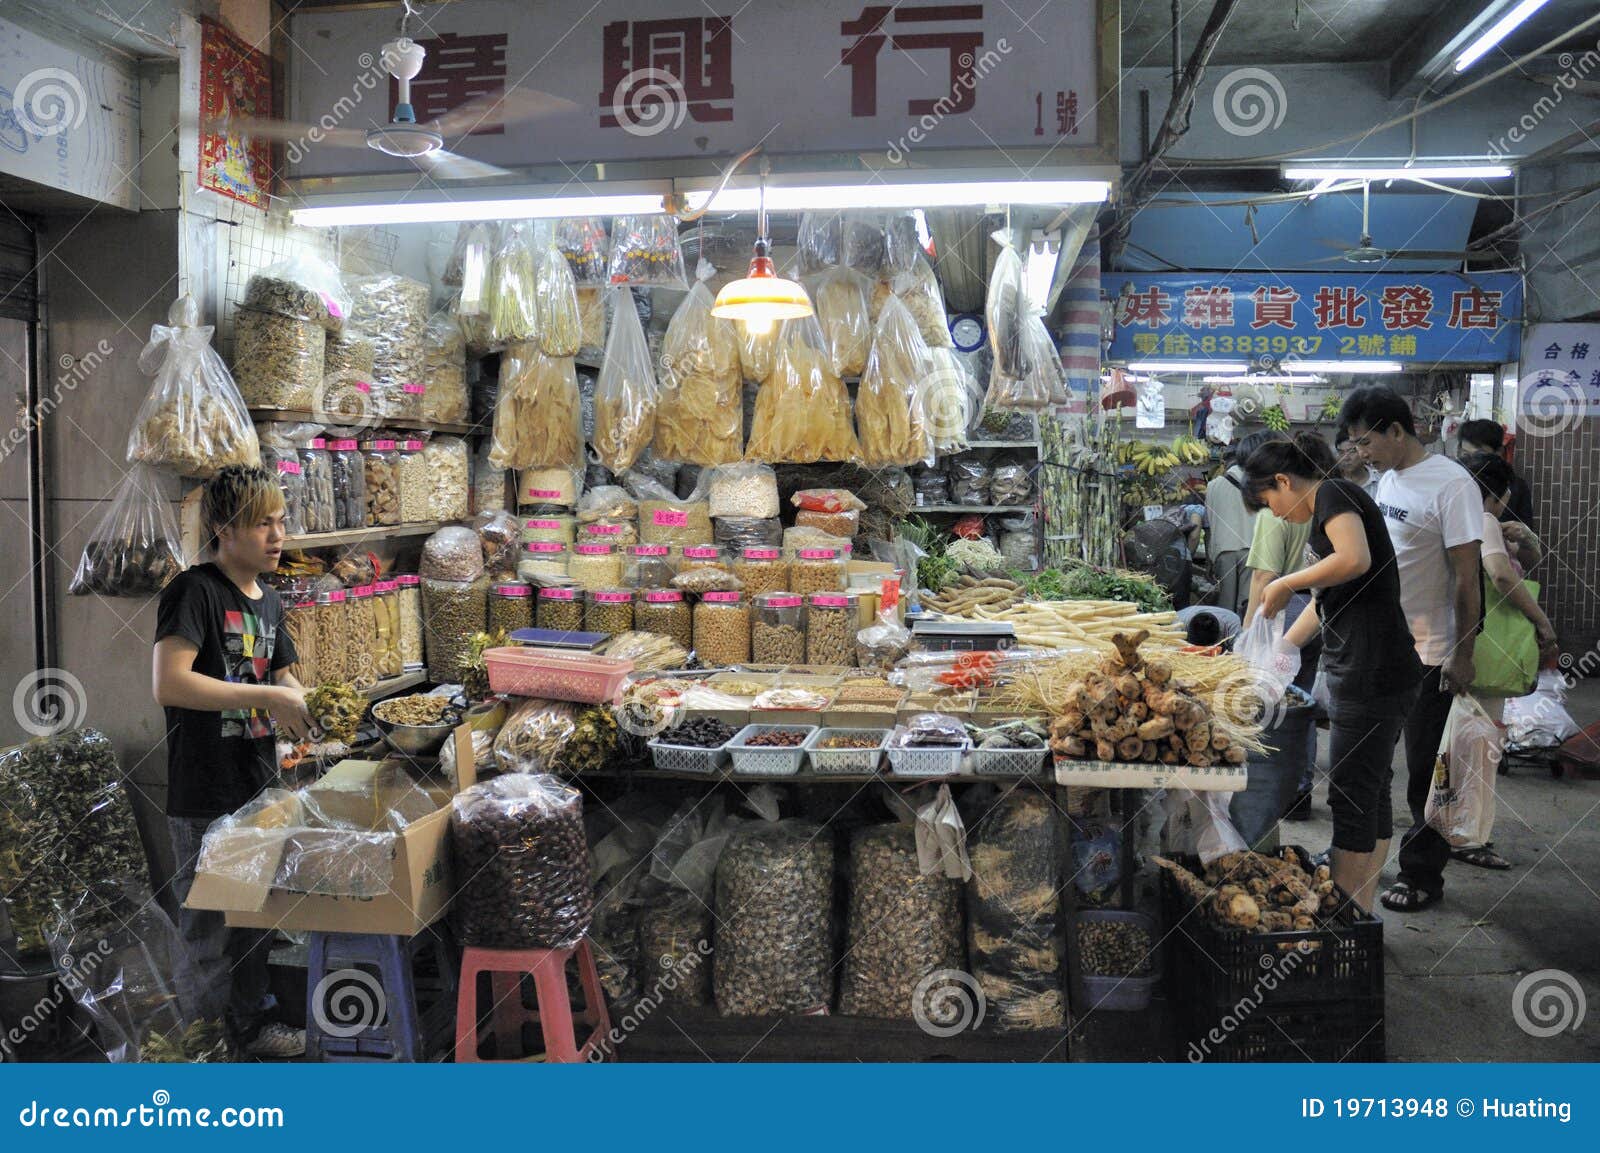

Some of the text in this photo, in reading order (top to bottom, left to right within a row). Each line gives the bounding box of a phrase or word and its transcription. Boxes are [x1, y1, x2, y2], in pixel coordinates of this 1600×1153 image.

[1117, 285, 1503, 331] 妹雜貨批發店
